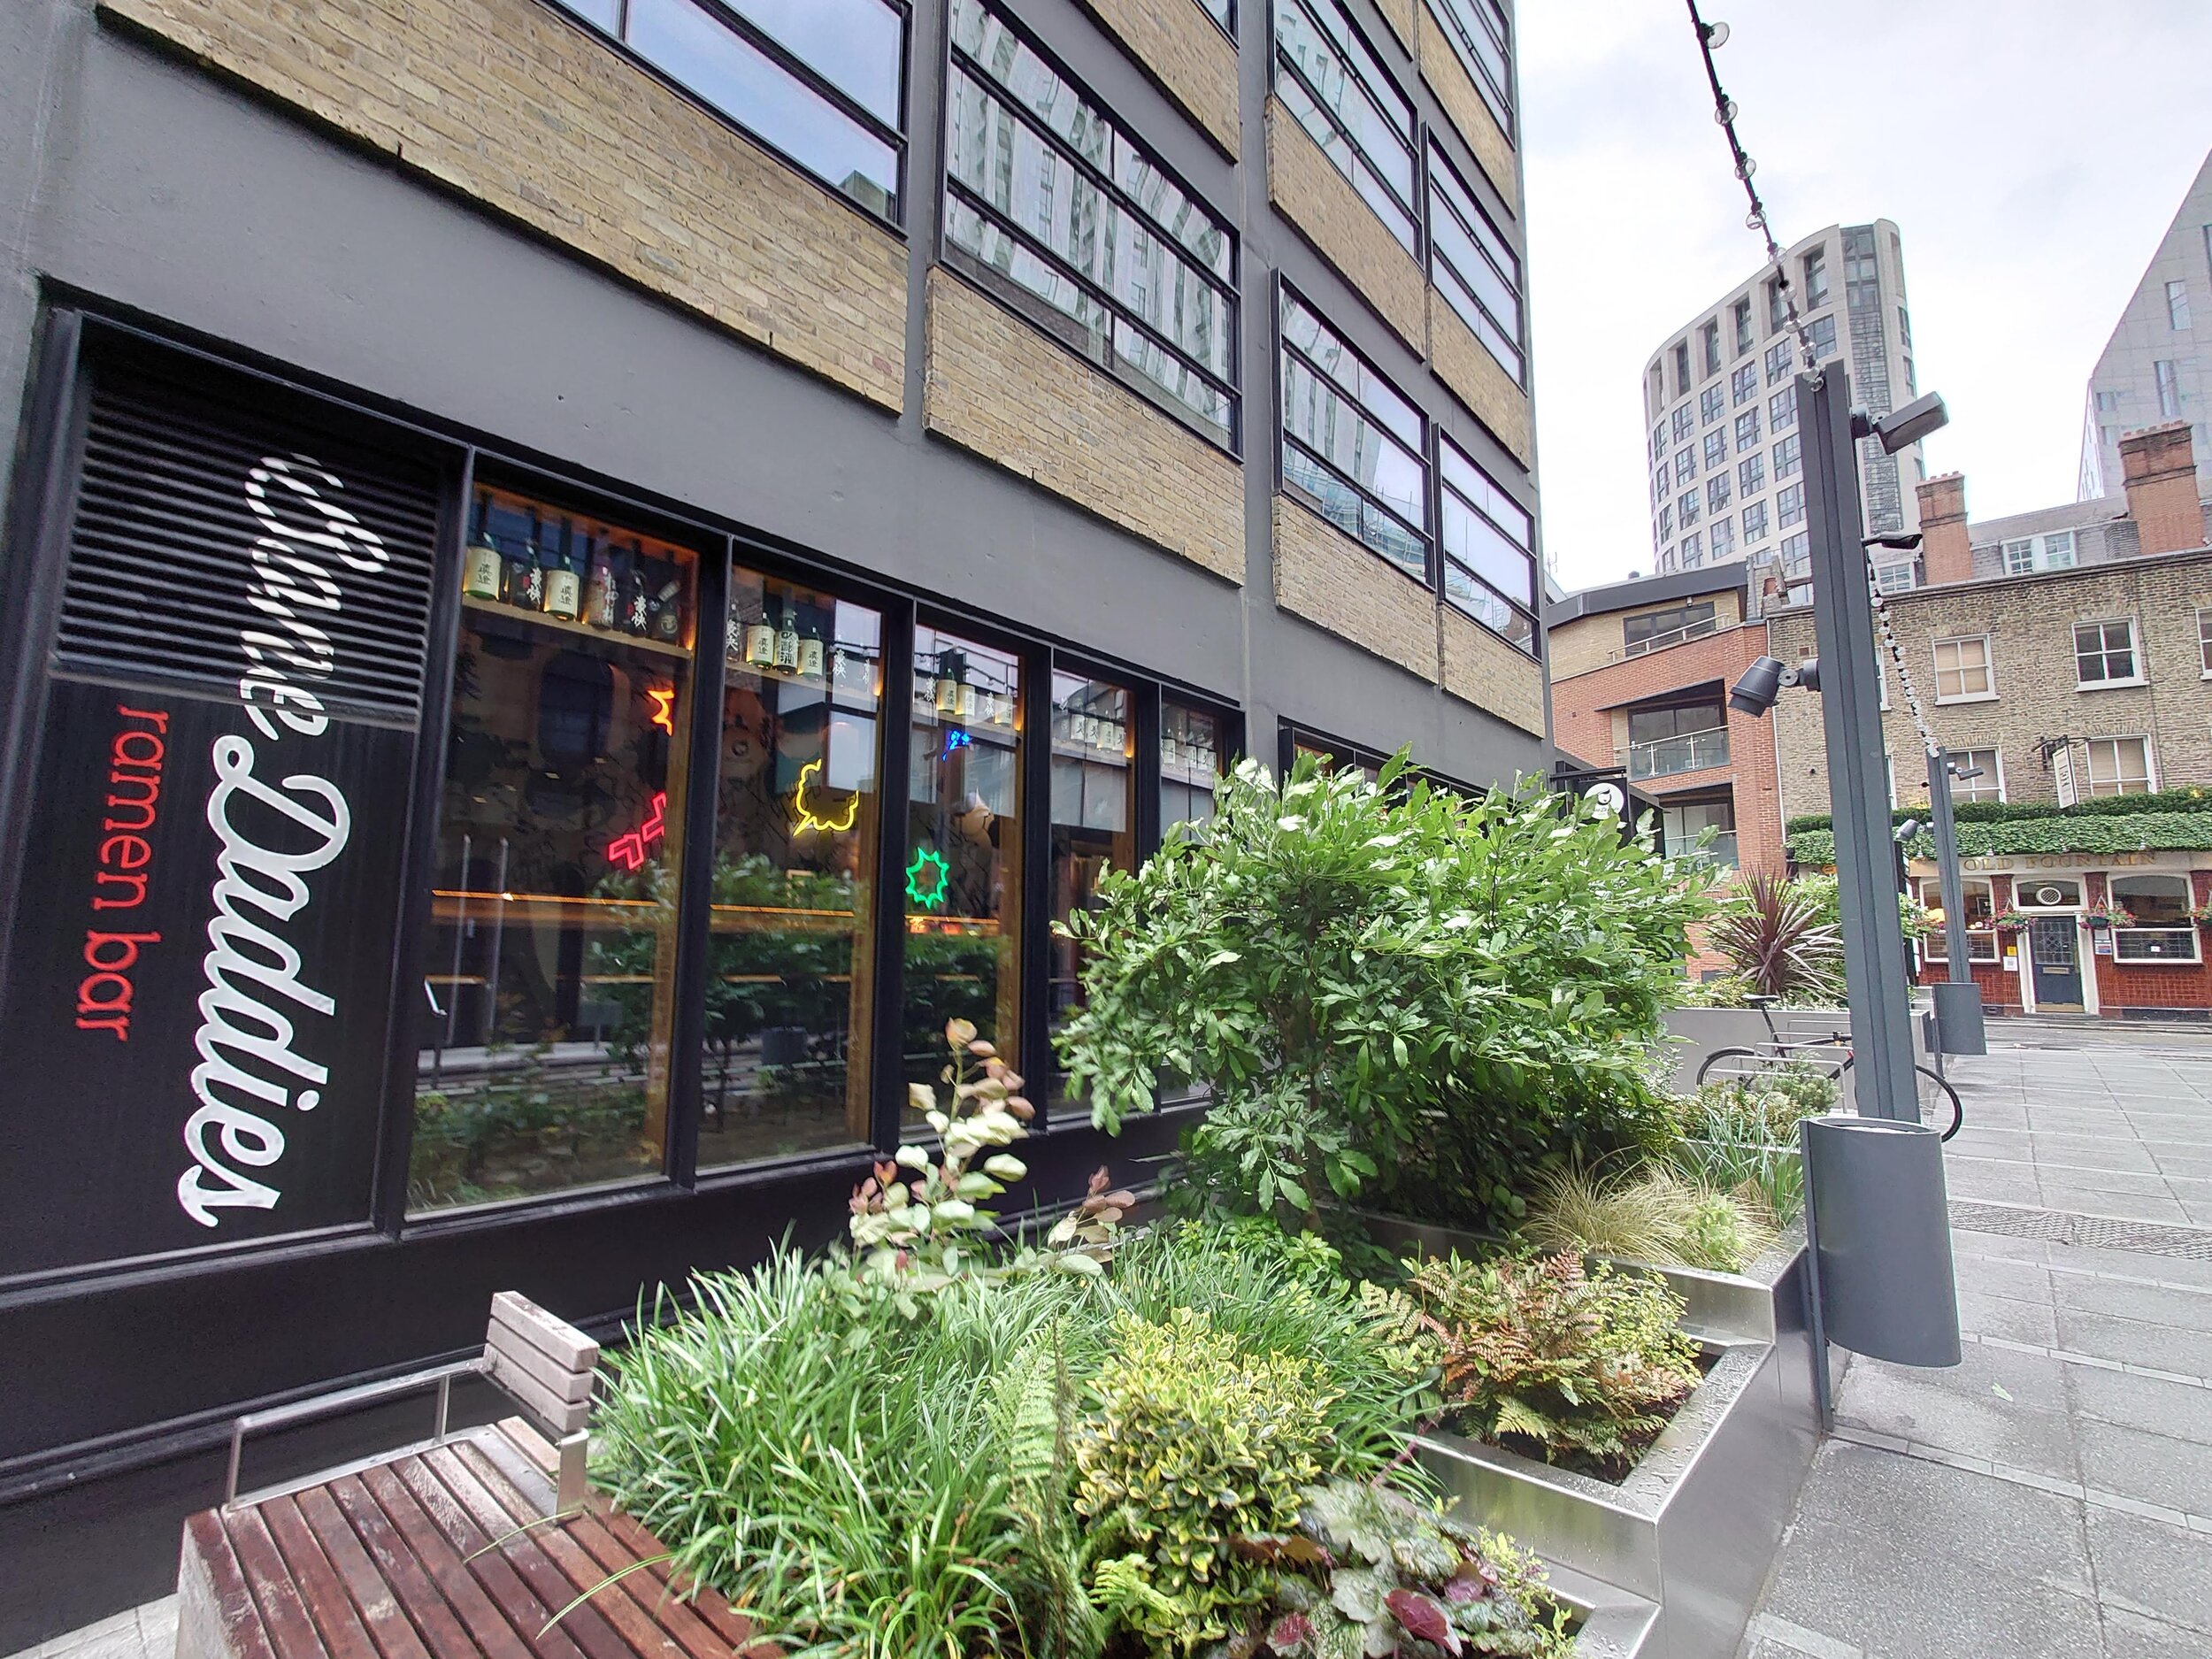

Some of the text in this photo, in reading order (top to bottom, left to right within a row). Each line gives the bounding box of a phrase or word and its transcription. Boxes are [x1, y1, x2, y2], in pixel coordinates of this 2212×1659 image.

[74, 705, 168, 1041] ramen bar
[178, 452, 390, 1226] Bone Daddies
[1963, 852, 2157, 871] OLD FOUNTAIN
